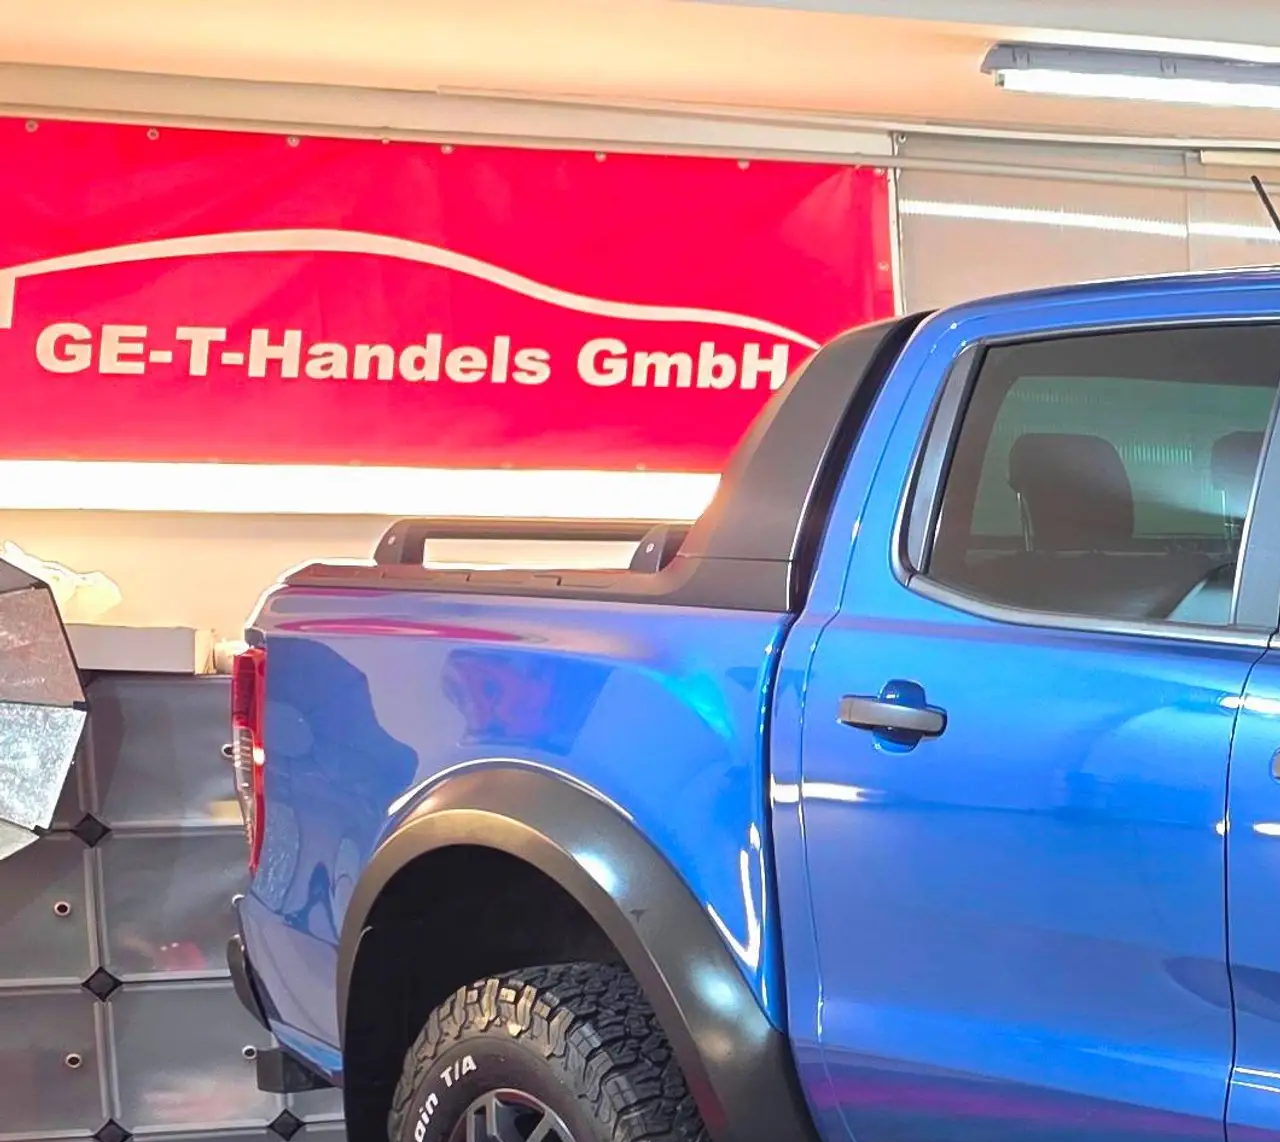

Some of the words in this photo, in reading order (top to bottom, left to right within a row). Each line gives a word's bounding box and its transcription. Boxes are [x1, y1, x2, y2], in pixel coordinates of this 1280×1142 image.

[35, 322, 552, 386] GE-T-Handels
[576, 337, 790, 390] GmbH
[440, 1054, 477, 1088] T/A
